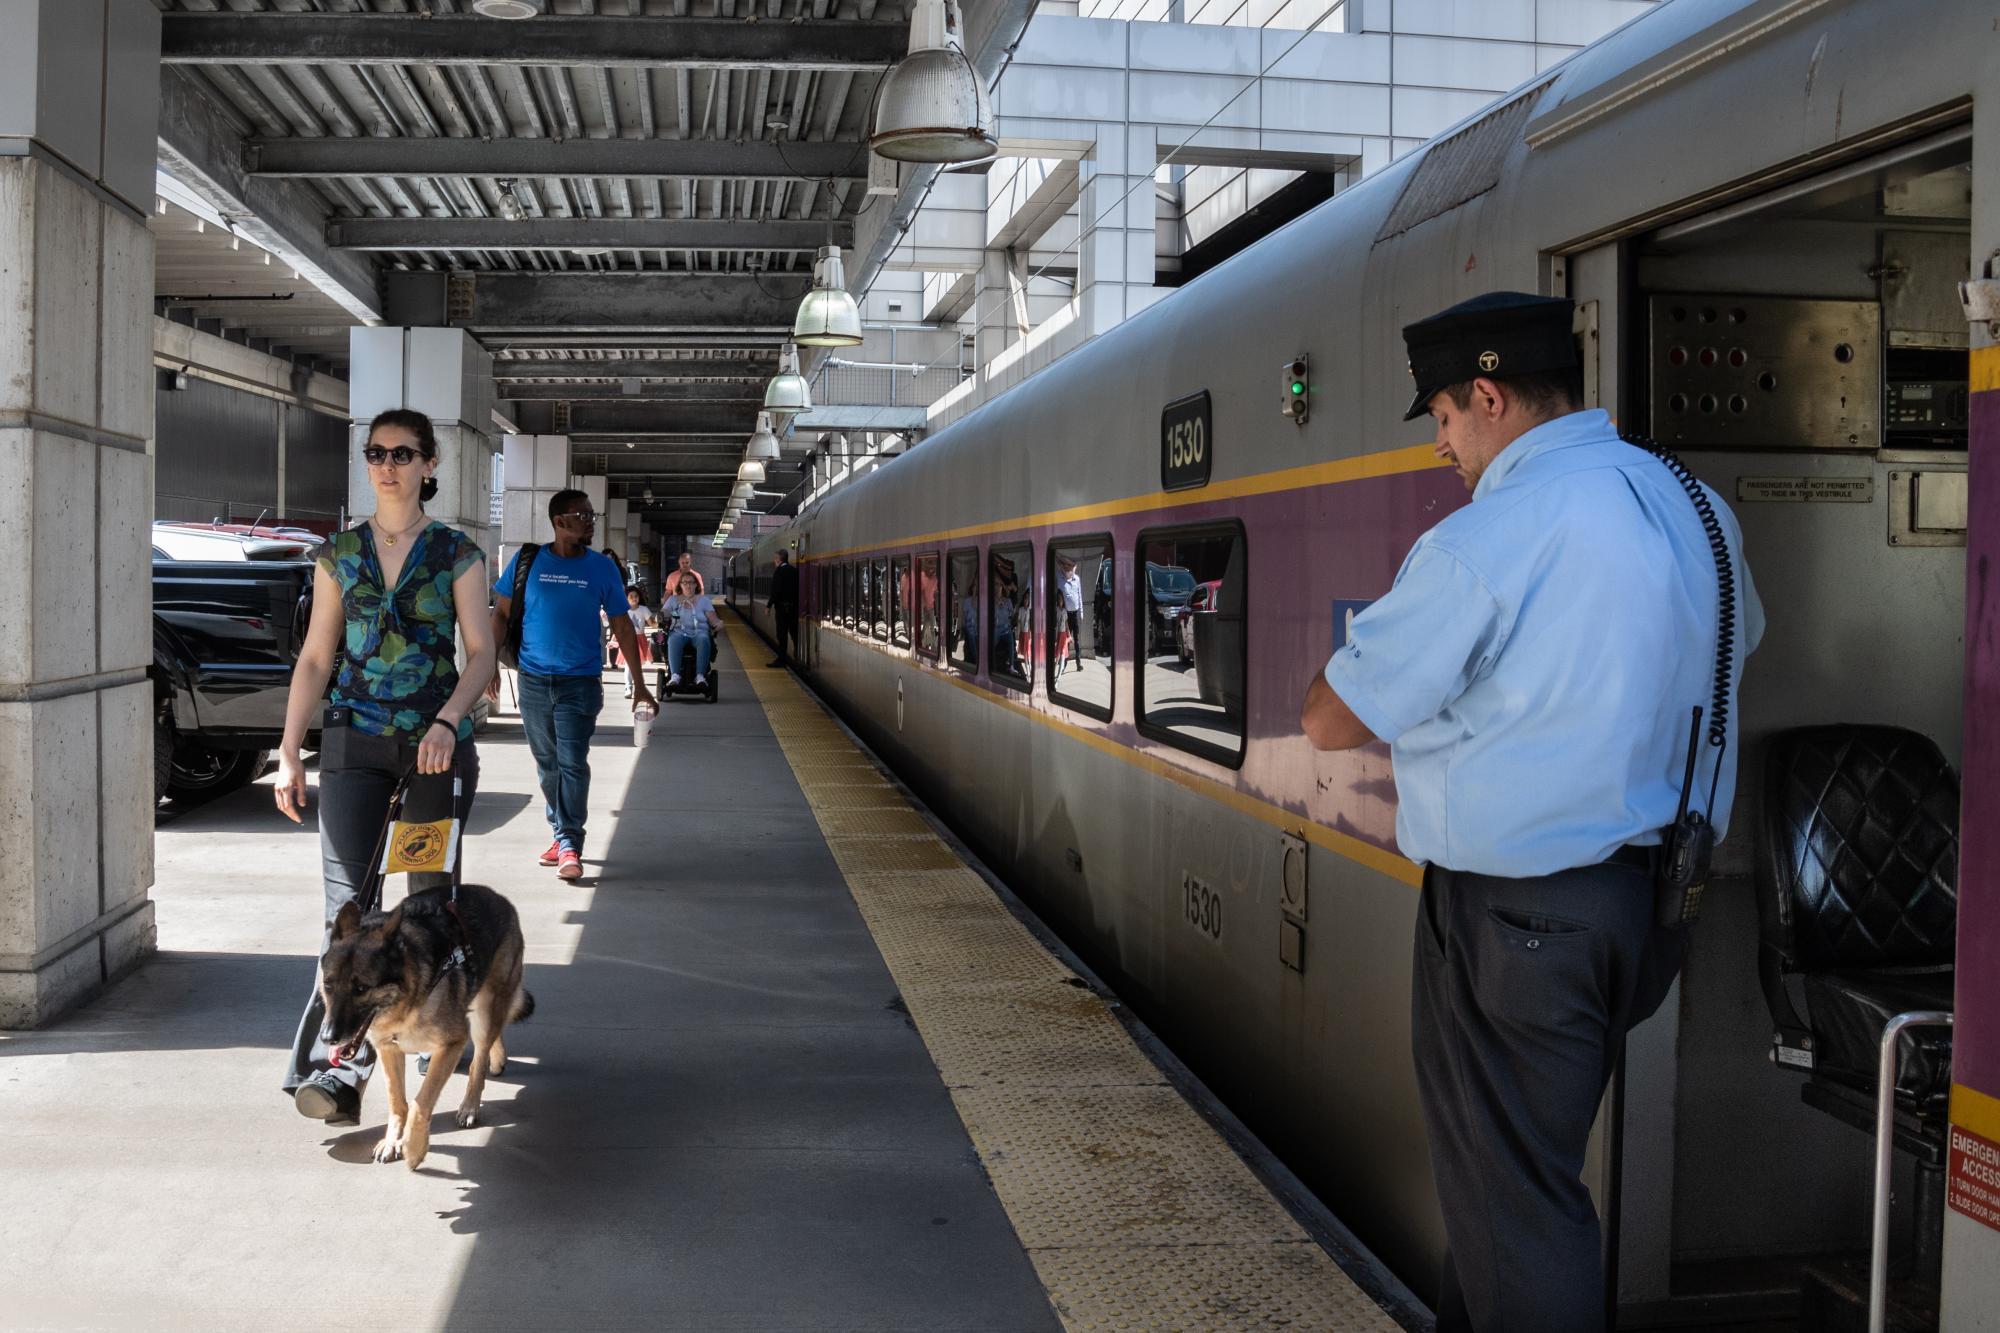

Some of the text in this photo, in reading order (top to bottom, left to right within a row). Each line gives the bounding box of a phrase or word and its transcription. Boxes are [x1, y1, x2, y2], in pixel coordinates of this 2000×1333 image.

[1168, 416, 1204, 468] 1530
[1184, 875, 1221, 939] 1530
[1952, 1132, 2000, 1168] EMERGEN
[1956, 1177, 1971, 1194] TURN
[1971, 1185, 1987, 1202] DOOR
[1962, 1158, 2000, 1189] ACCESS
[1955, 1194, 1971, 1211] SLIDE
[1972, 1202, 1988, 1218] DOOR
